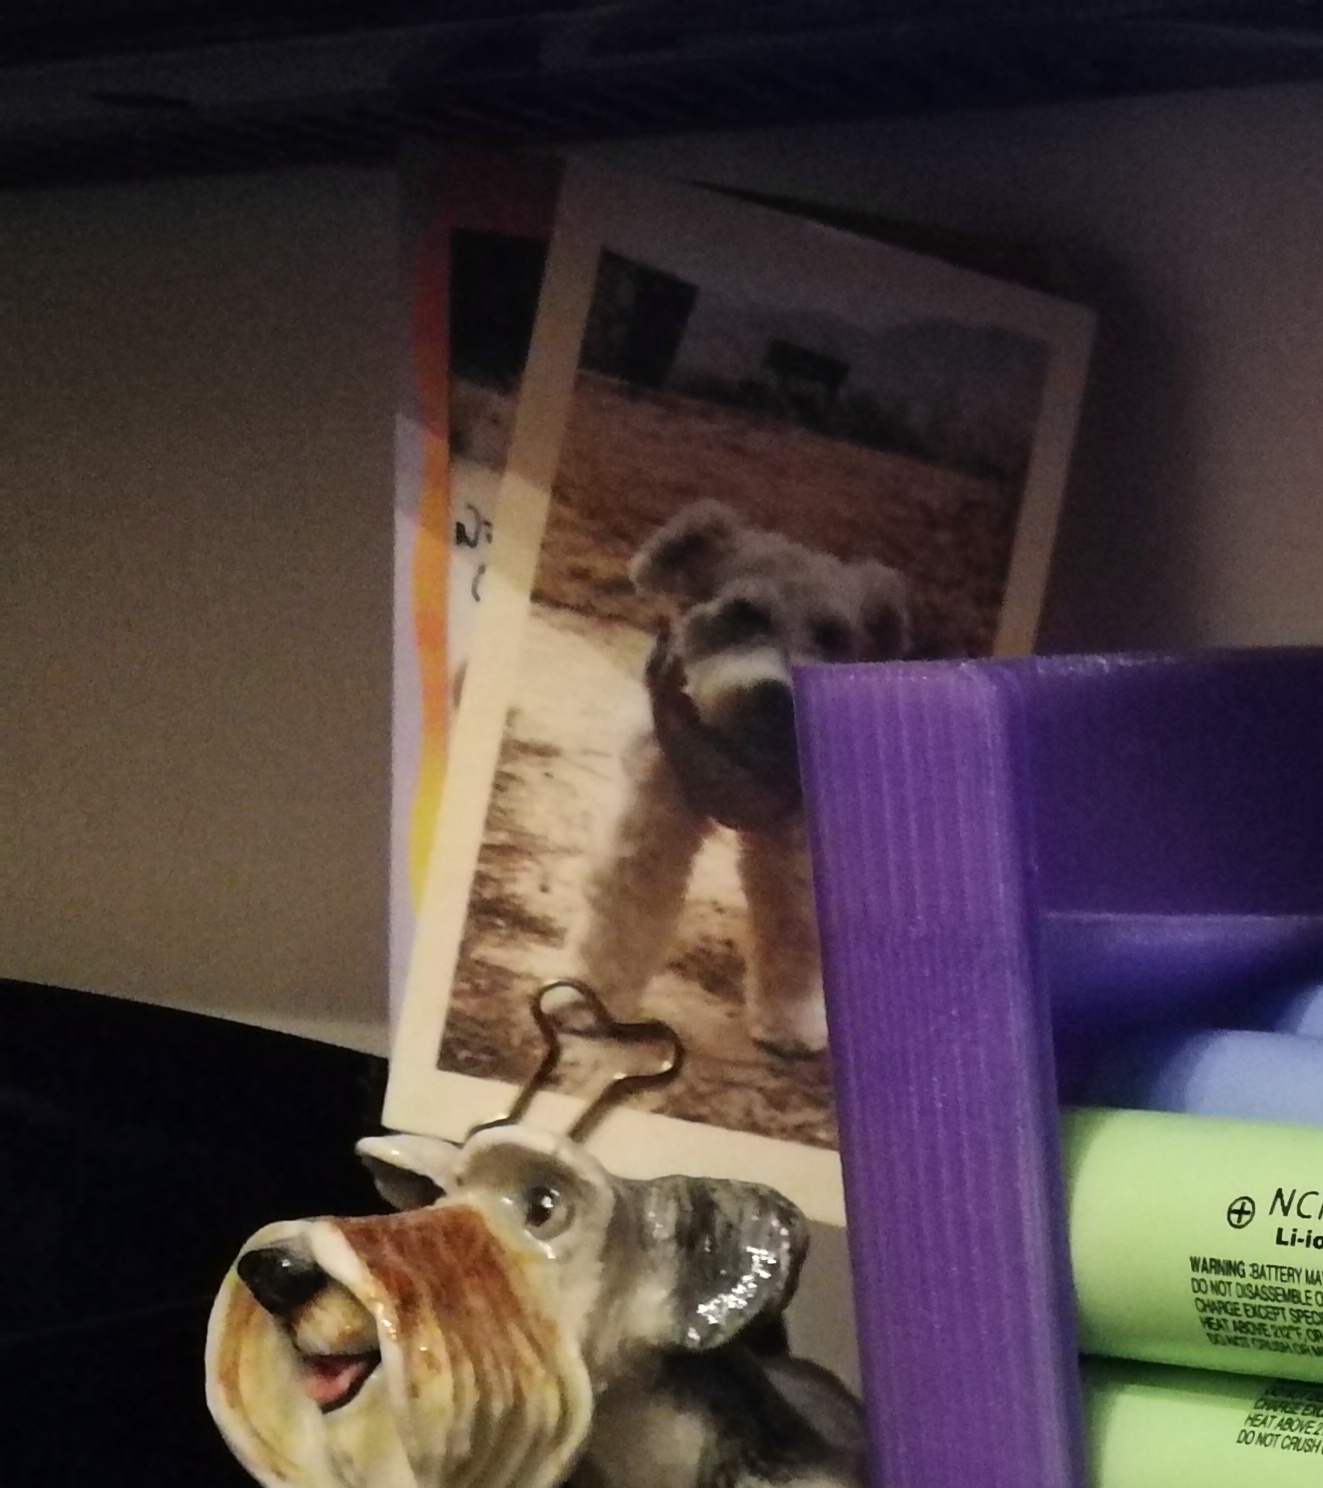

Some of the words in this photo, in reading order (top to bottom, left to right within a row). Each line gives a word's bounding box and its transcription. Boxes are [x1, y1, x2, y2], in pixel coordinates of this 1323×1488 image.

[1191, 1278, 1208, 1294] DO
[1210, 1281, 1232, 1297] NOT
[1236, 1429, 1255, 1445] DO
[1255, 1431, 1281, 1448] NOT
[1281, 1435, 1322, 1453] CRUSH
